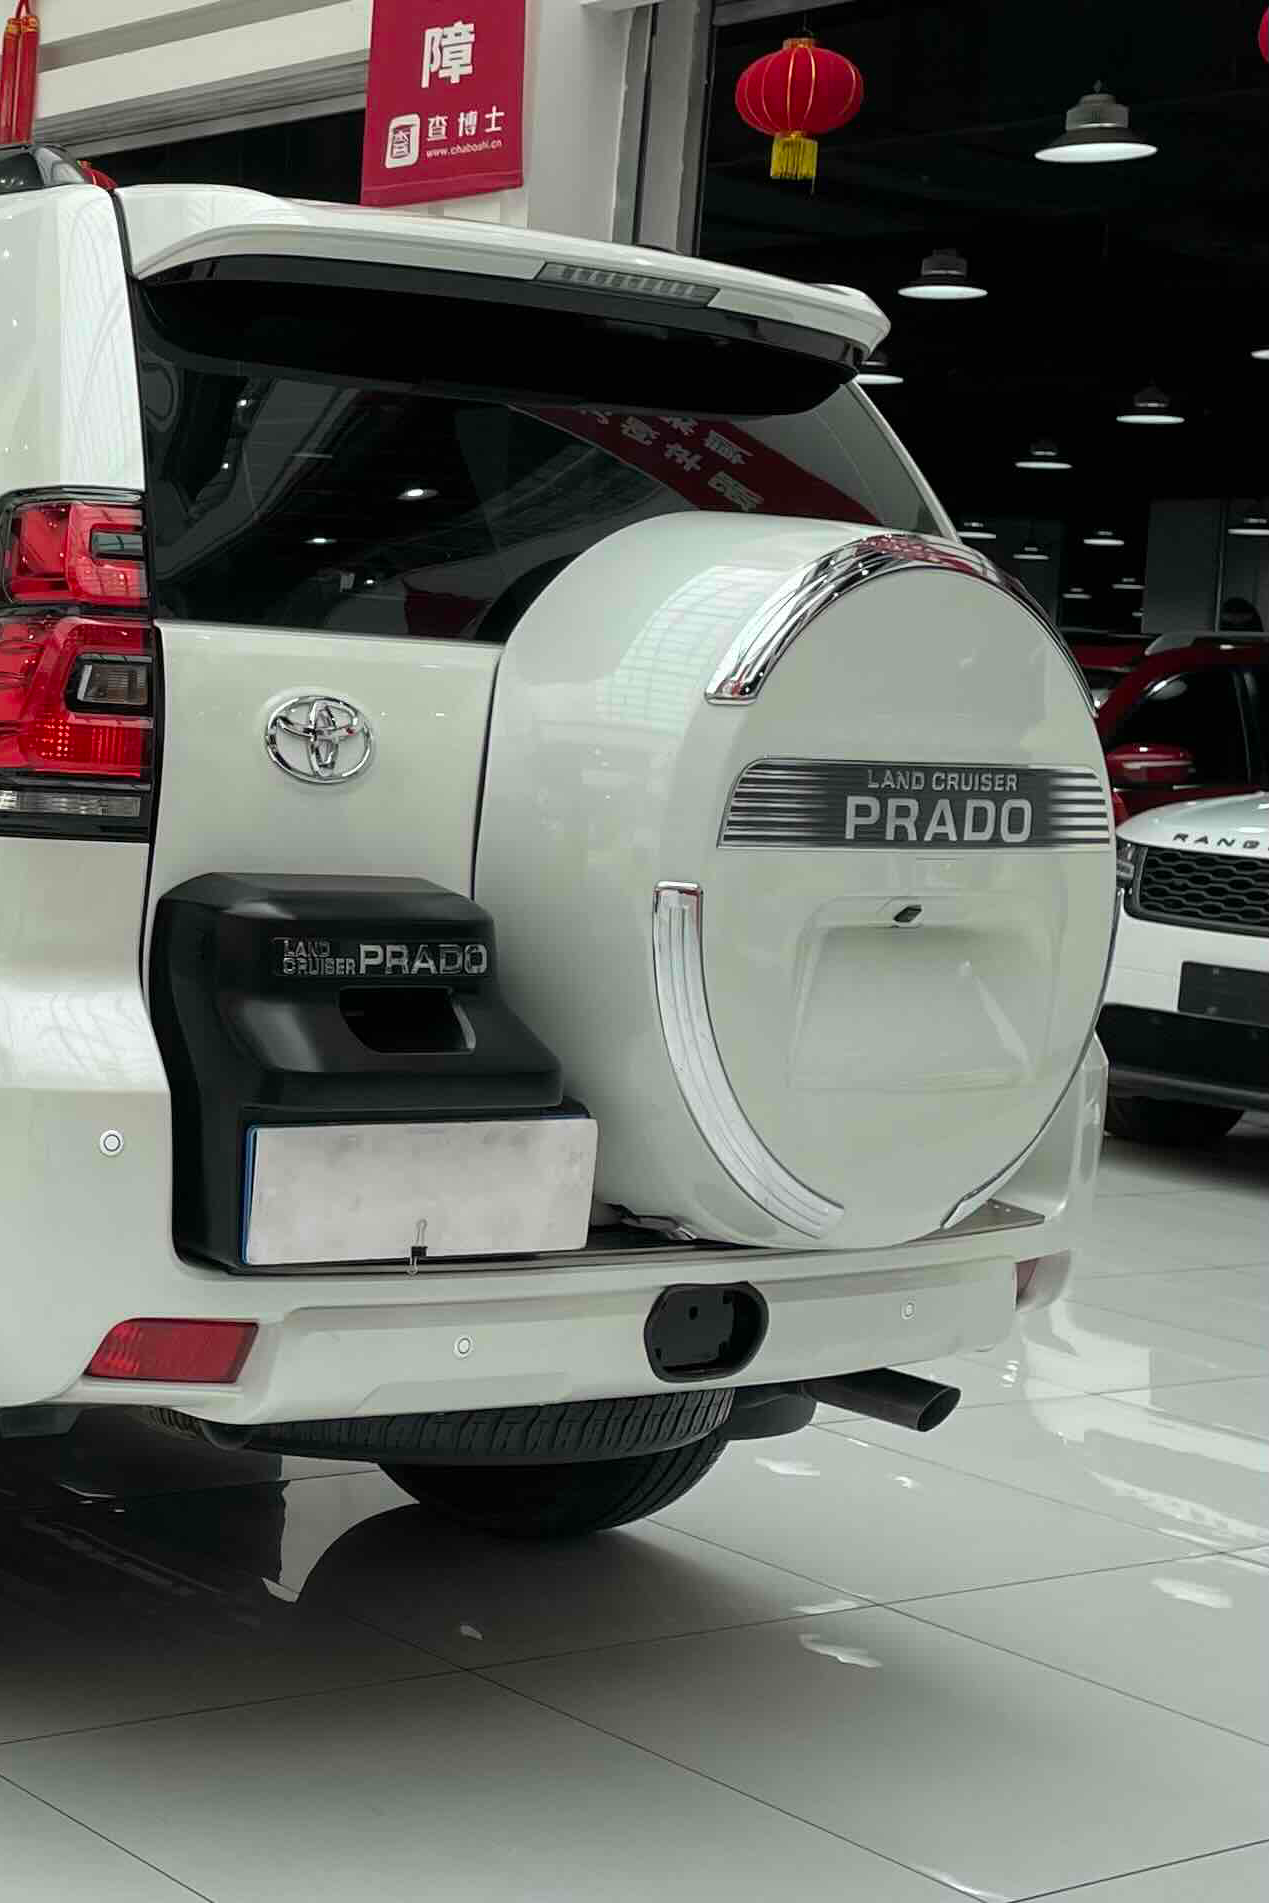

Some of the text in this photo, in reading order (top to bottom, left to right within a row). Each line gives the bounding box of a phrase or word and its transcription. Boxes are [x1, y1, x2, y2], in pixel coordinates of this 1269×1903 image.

[421, 20, 476, 89] 障
[426, 105, 505, 142] 查博士
[867, 769, 1019, 793] LAND CRUISER
[844, 795, 1033, 844] PRADO
[1172, 832, 1269, 852] RANG
[284, 939, 331, 958] LAND
[359, 943, 489, 975] PRADO
[283, 957, 357, 976] CRUISER
